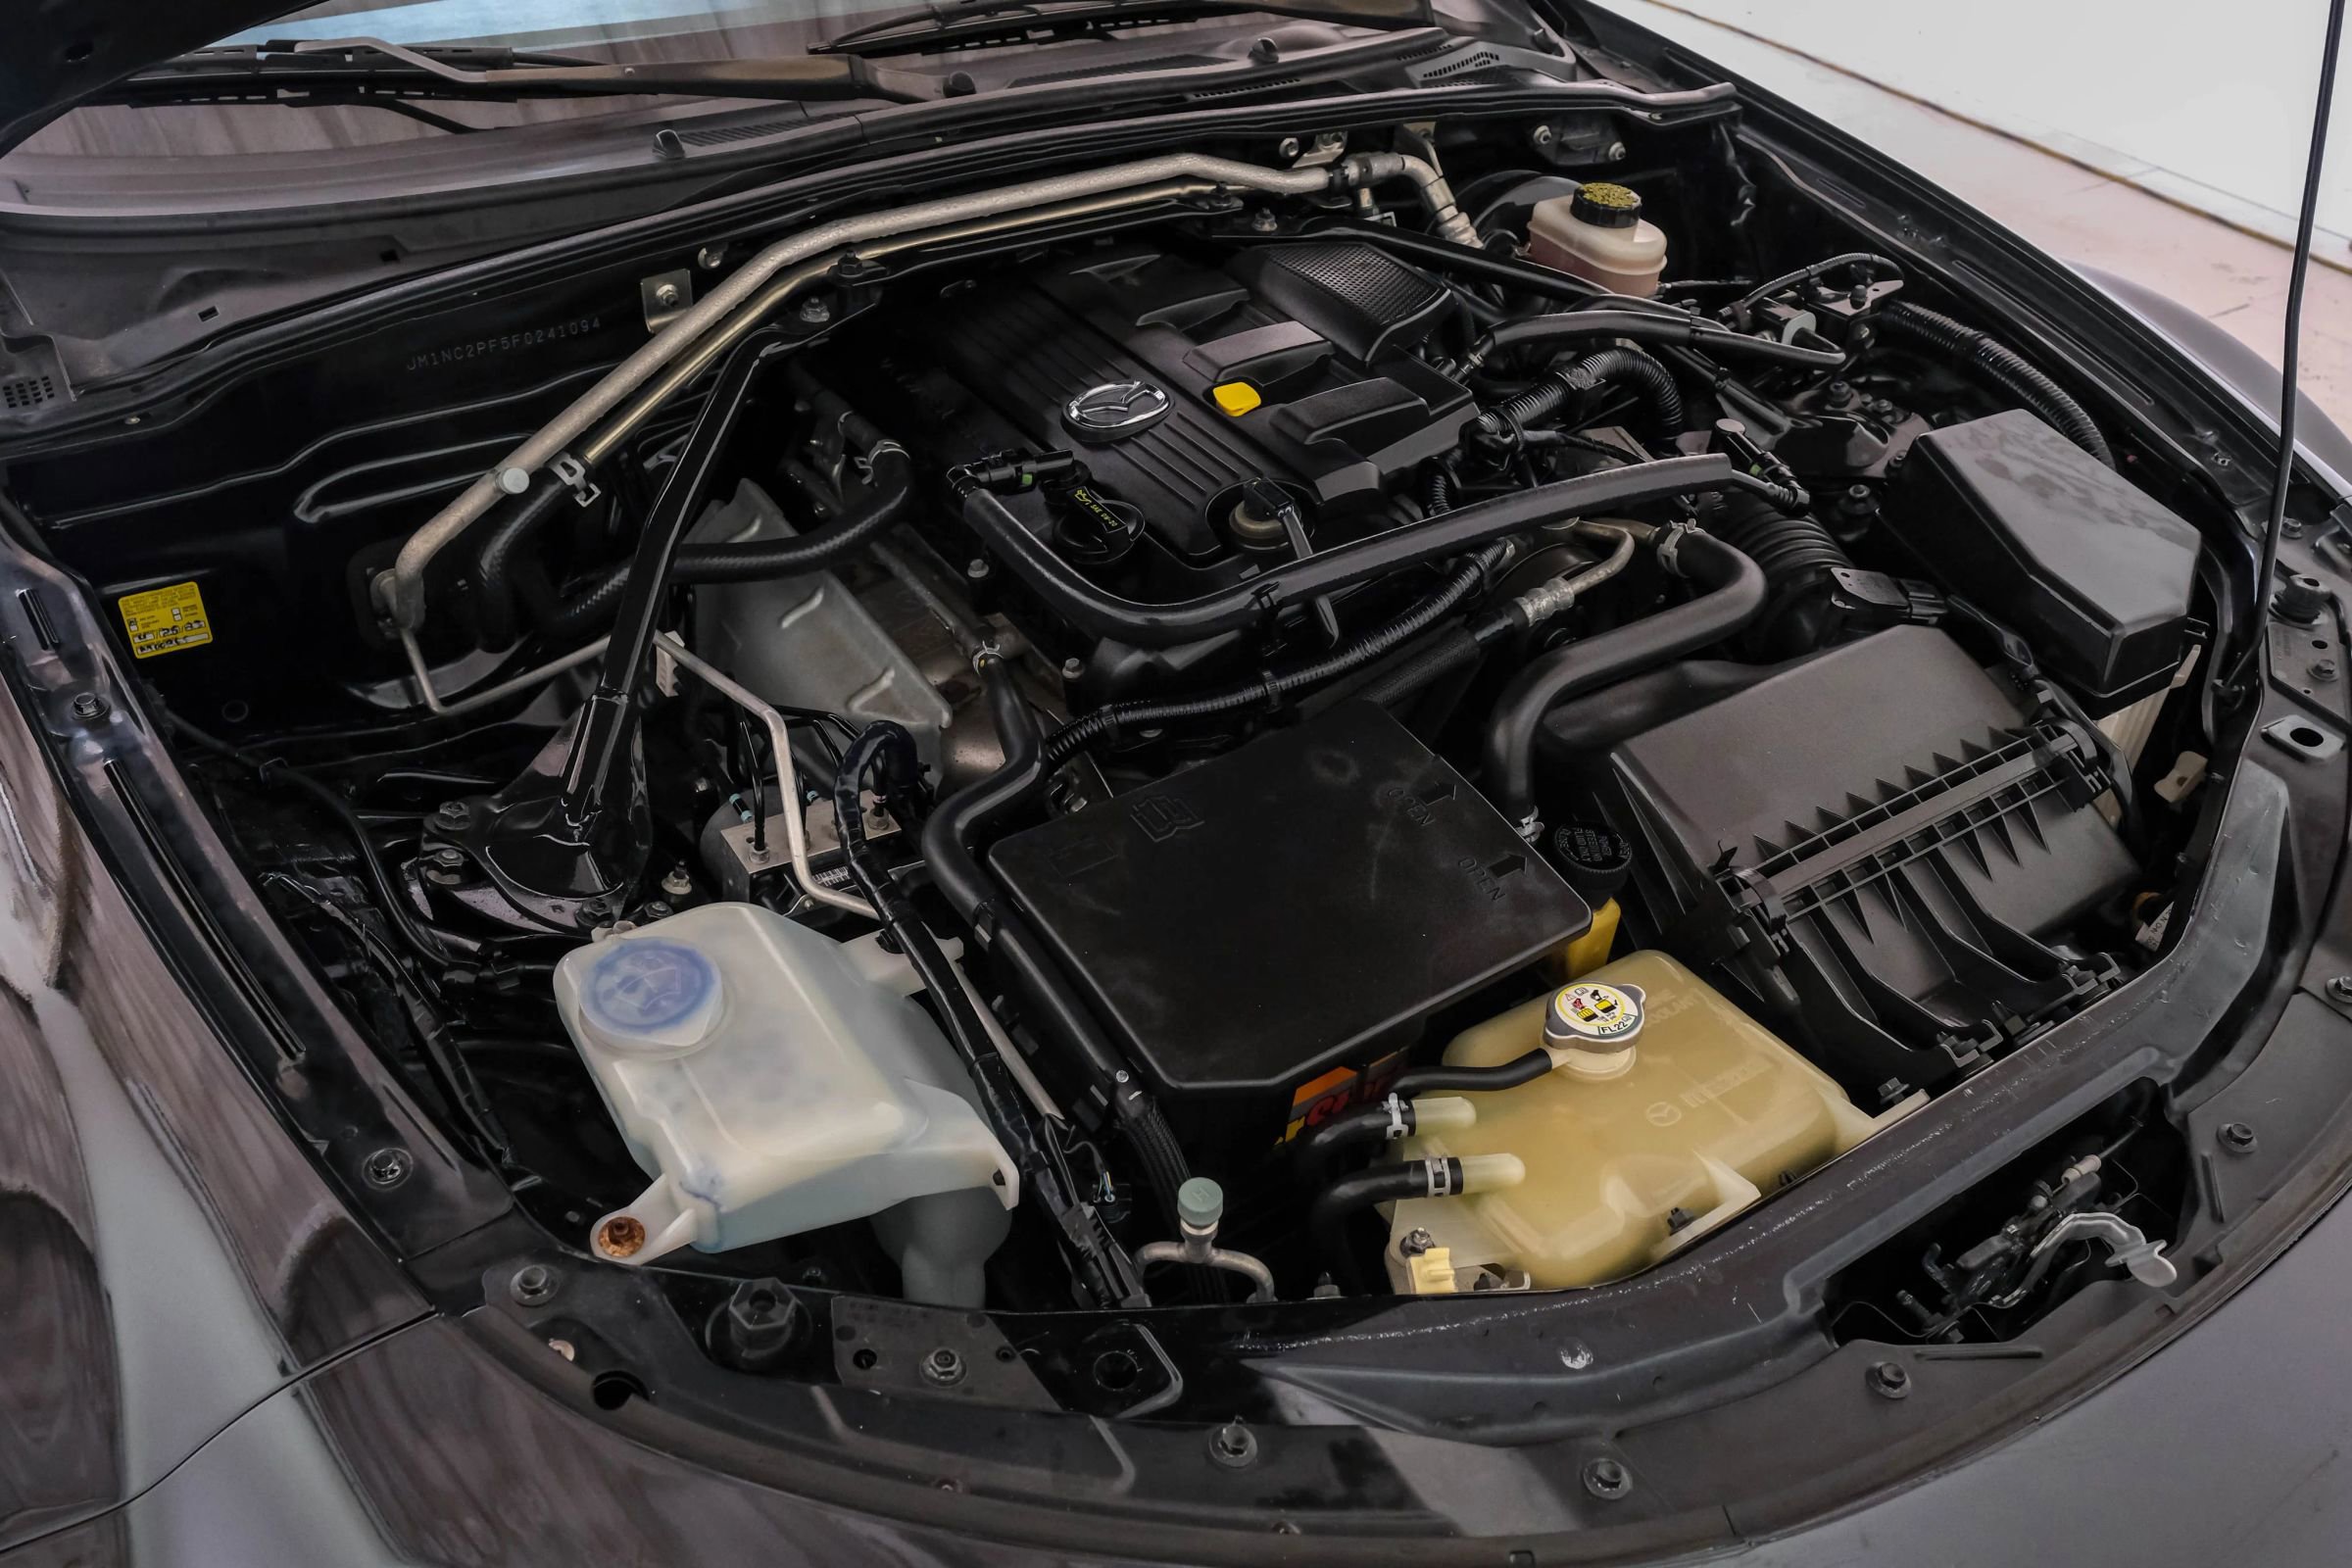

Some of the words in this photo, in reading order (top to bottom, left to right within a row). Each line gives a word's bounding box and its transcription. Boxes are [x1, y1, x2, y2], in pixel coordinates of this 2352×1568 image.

[1090, 504, 1102, 514] SAE
[1457, 857, 1506, 902] OPEN
[1600, 1021, 1628, 1034] FL22
